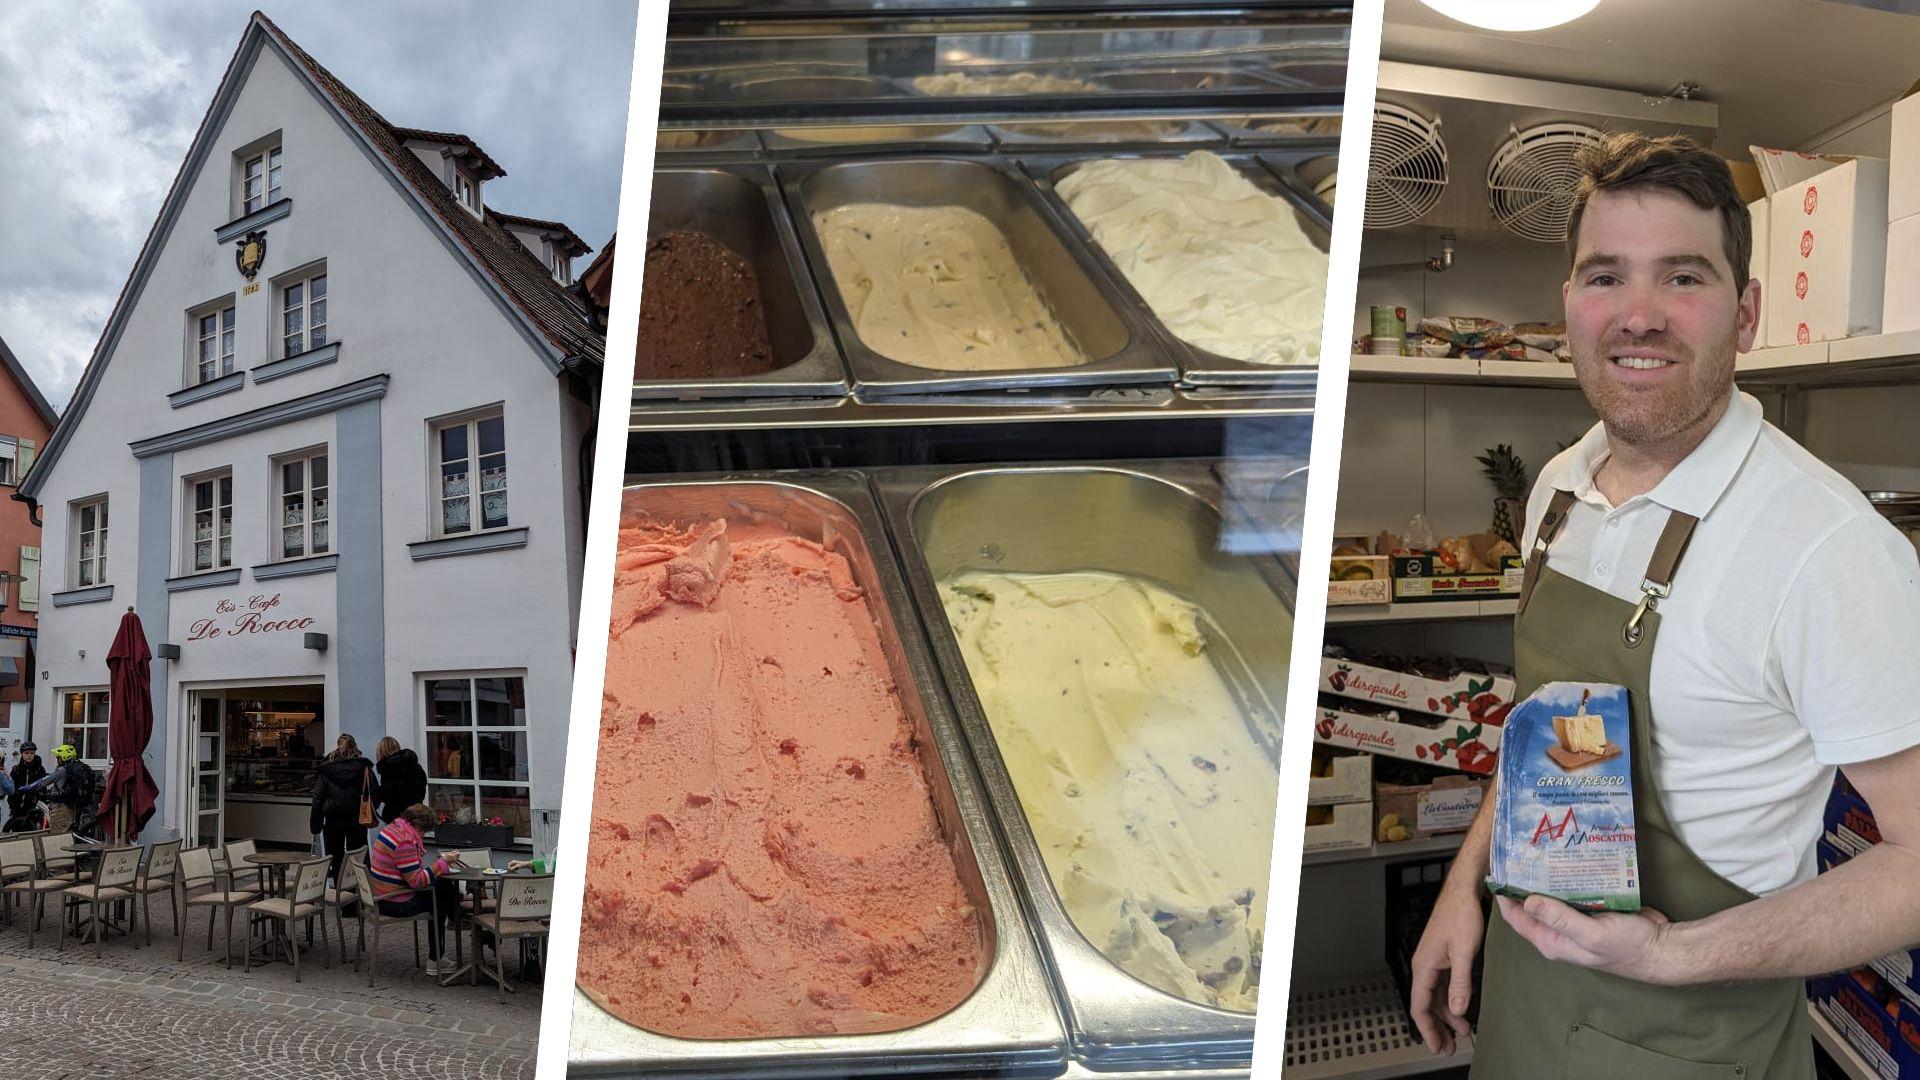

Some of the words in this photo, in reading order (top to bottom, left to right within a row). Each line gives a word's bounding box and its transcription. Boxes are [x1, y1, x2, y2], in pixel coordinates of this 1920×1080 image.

[216, 599, 236, 613] Eis
[187, 618, 222, 641] De
[227, 612, 315, 637] Rocco
[41, 670, 49, 680] 10
[1328, 669, 1407, 699] Sidiropoulos
[1315, 718, 1395, 747] Sidiropoulos
[1536, 775, 1574, 788] GRAN
[1577, 775, 1625, 787] FRESCO
